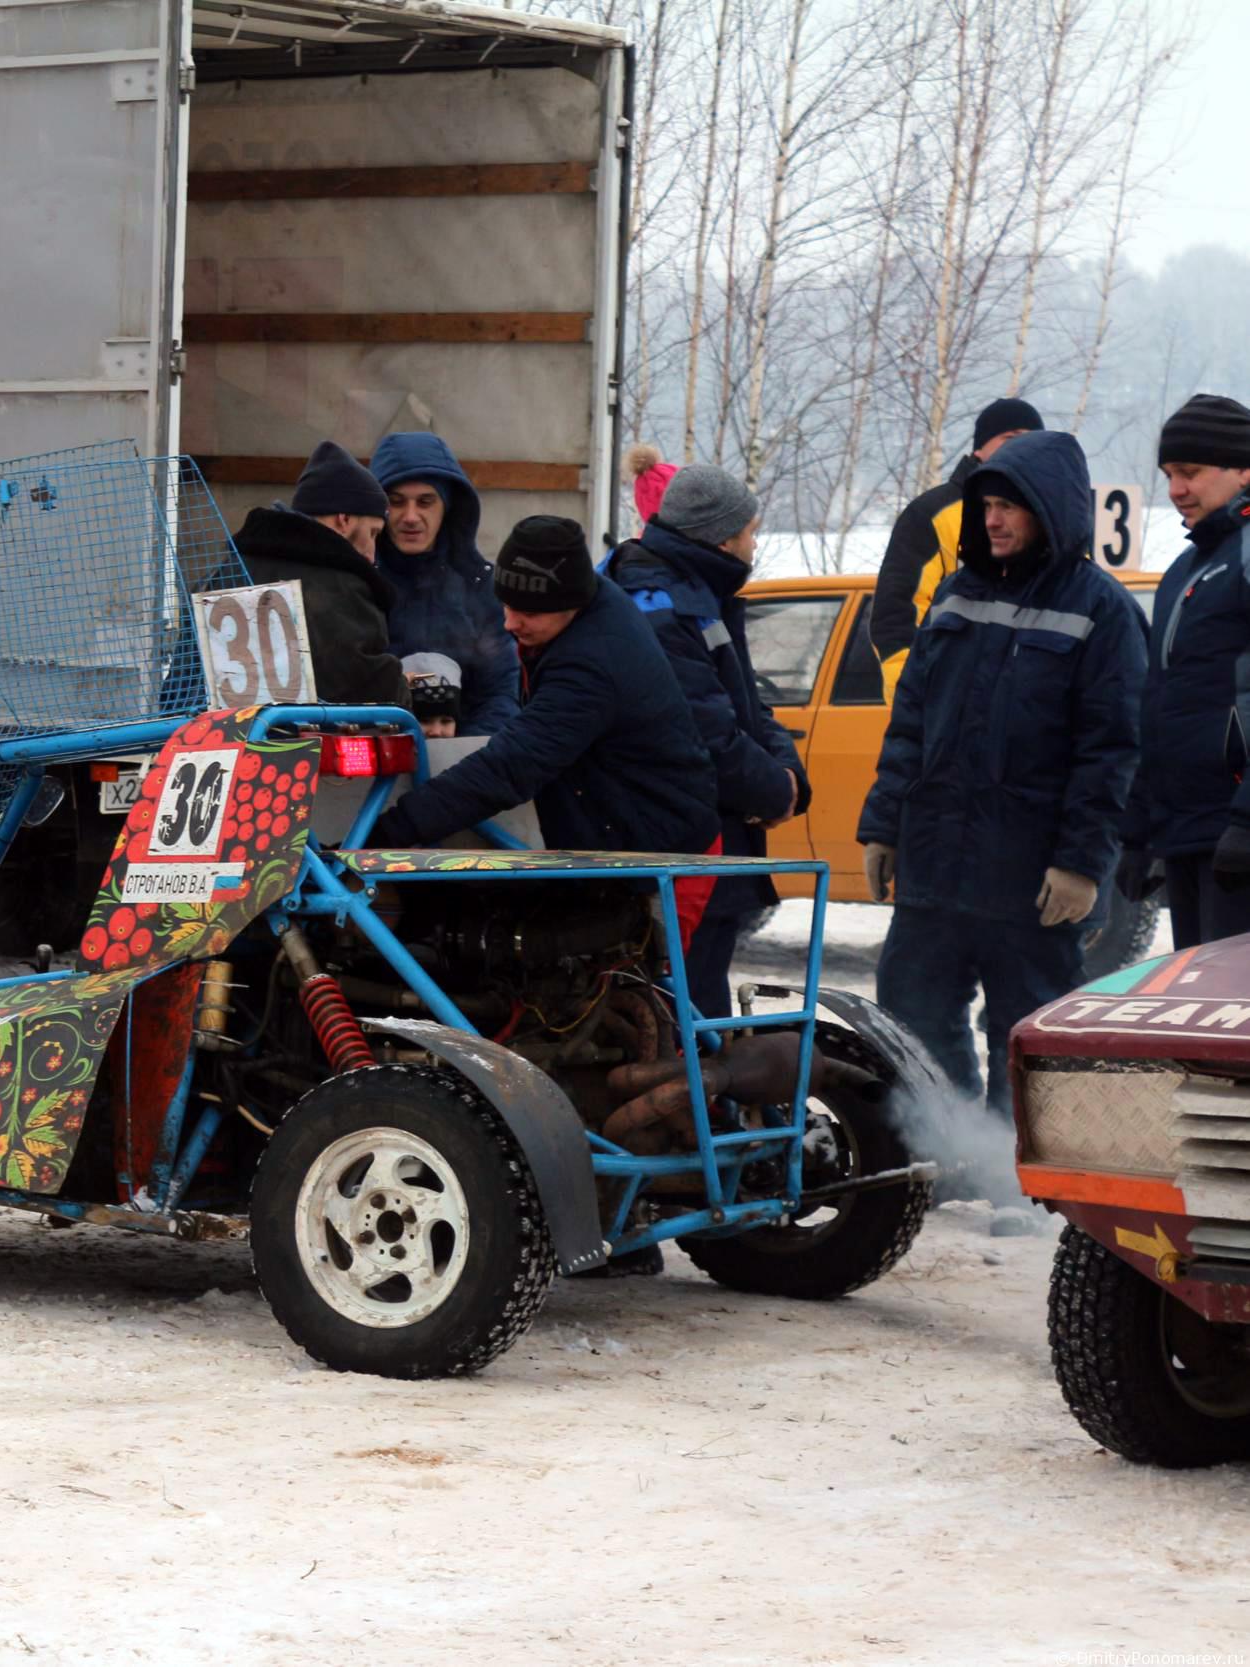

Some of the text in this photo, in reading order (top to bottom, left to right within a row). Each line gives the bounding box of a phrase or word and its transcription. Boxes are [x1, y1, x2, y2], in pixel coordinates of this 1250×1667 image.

[209, 590, 301, 709] 30
[158, 761, 224, 846] 30
[125, 874, 186, 894] СТРОГАНОВ
[1065, 1001, 1250, 1029] TEAM
